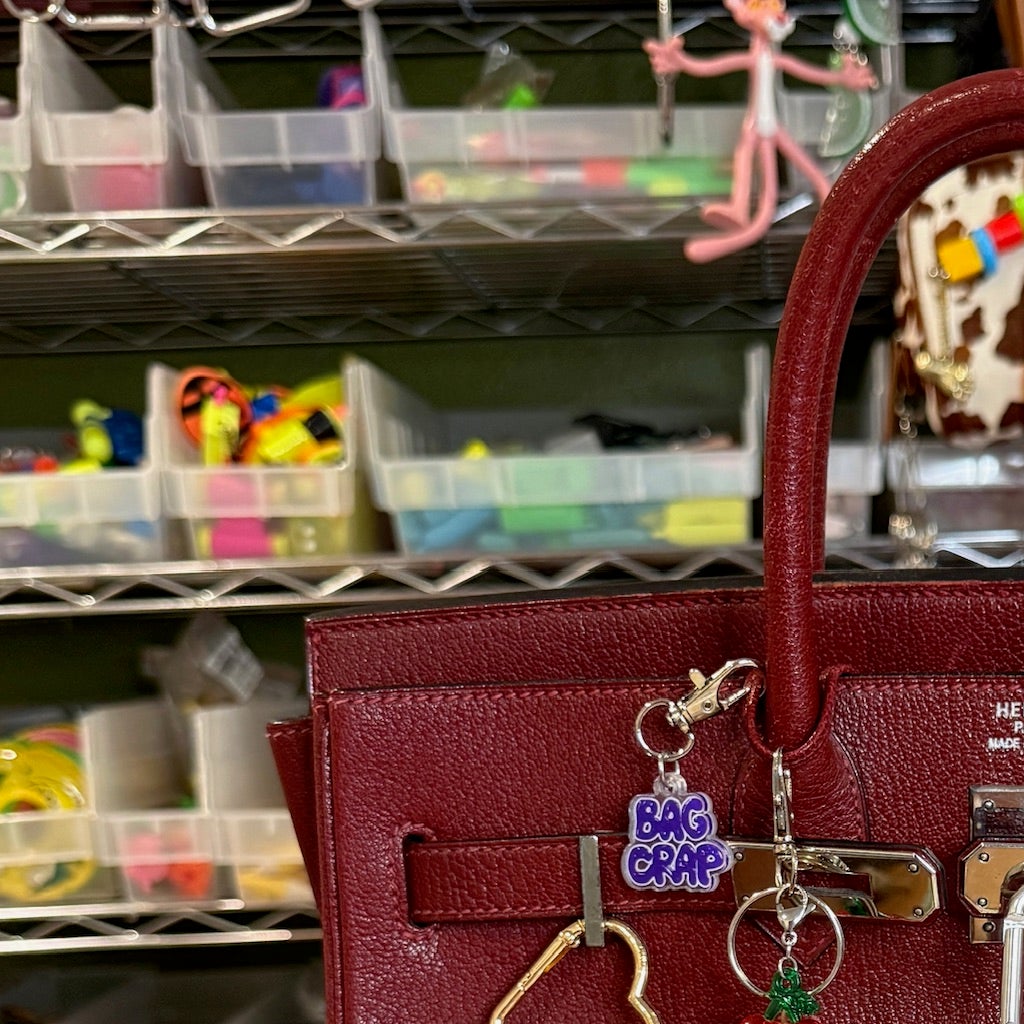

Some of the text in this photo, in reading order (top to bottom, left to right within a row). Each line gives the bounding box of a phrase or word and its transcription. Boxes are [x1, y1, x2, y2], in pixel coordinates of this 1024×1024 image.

[988, 737, 1020, 749] MADE
[635, 796, 712, 843] BAG
[627, 841, 728, 888] CRAP
